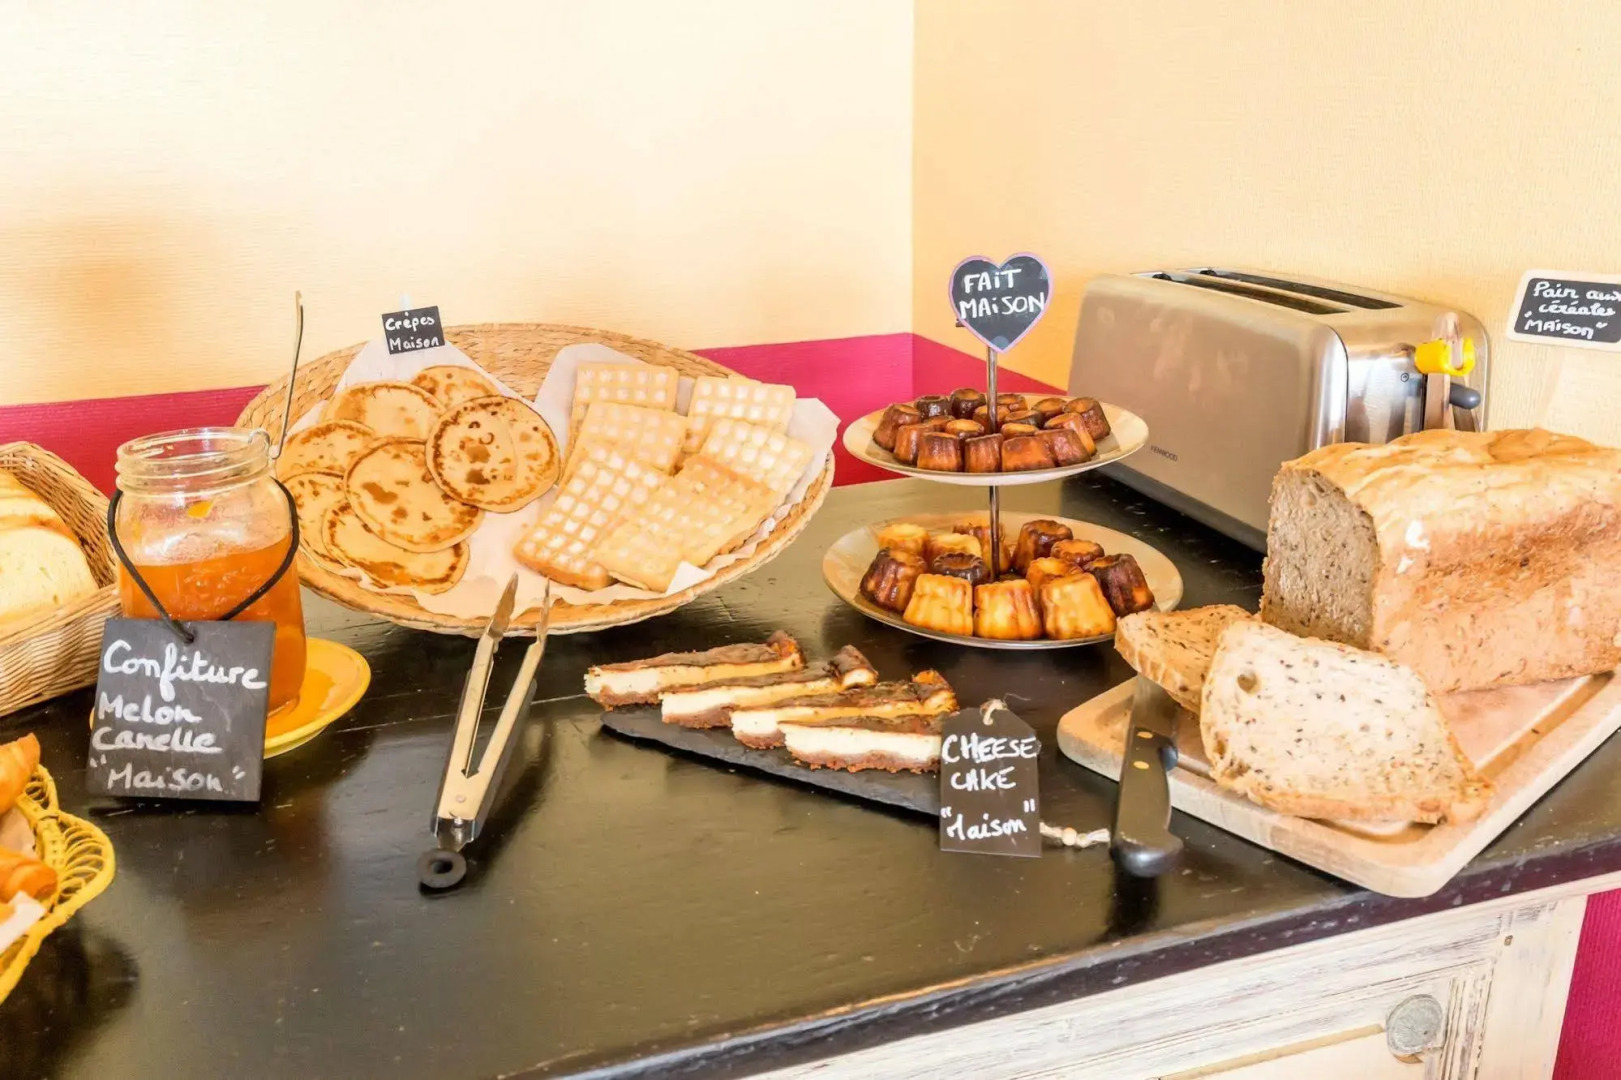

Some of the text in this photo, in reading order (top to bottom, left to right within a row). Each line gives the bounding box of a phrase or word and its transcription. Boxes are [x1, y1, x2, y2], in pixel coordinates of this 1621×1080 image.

[1533, 281, 1579, 299] Pain
[1539, 300, 1616, 316] céréales
[389, 336, 439, 351] Maison
[103, 639, 267, 702] Confiture
[98, 692, 203, 725] Melon
[92, 726, 223, 753] Canelle
[941, 732, 1038, 763] CHEESE
[950, 766, 1017, 792] CAKE
